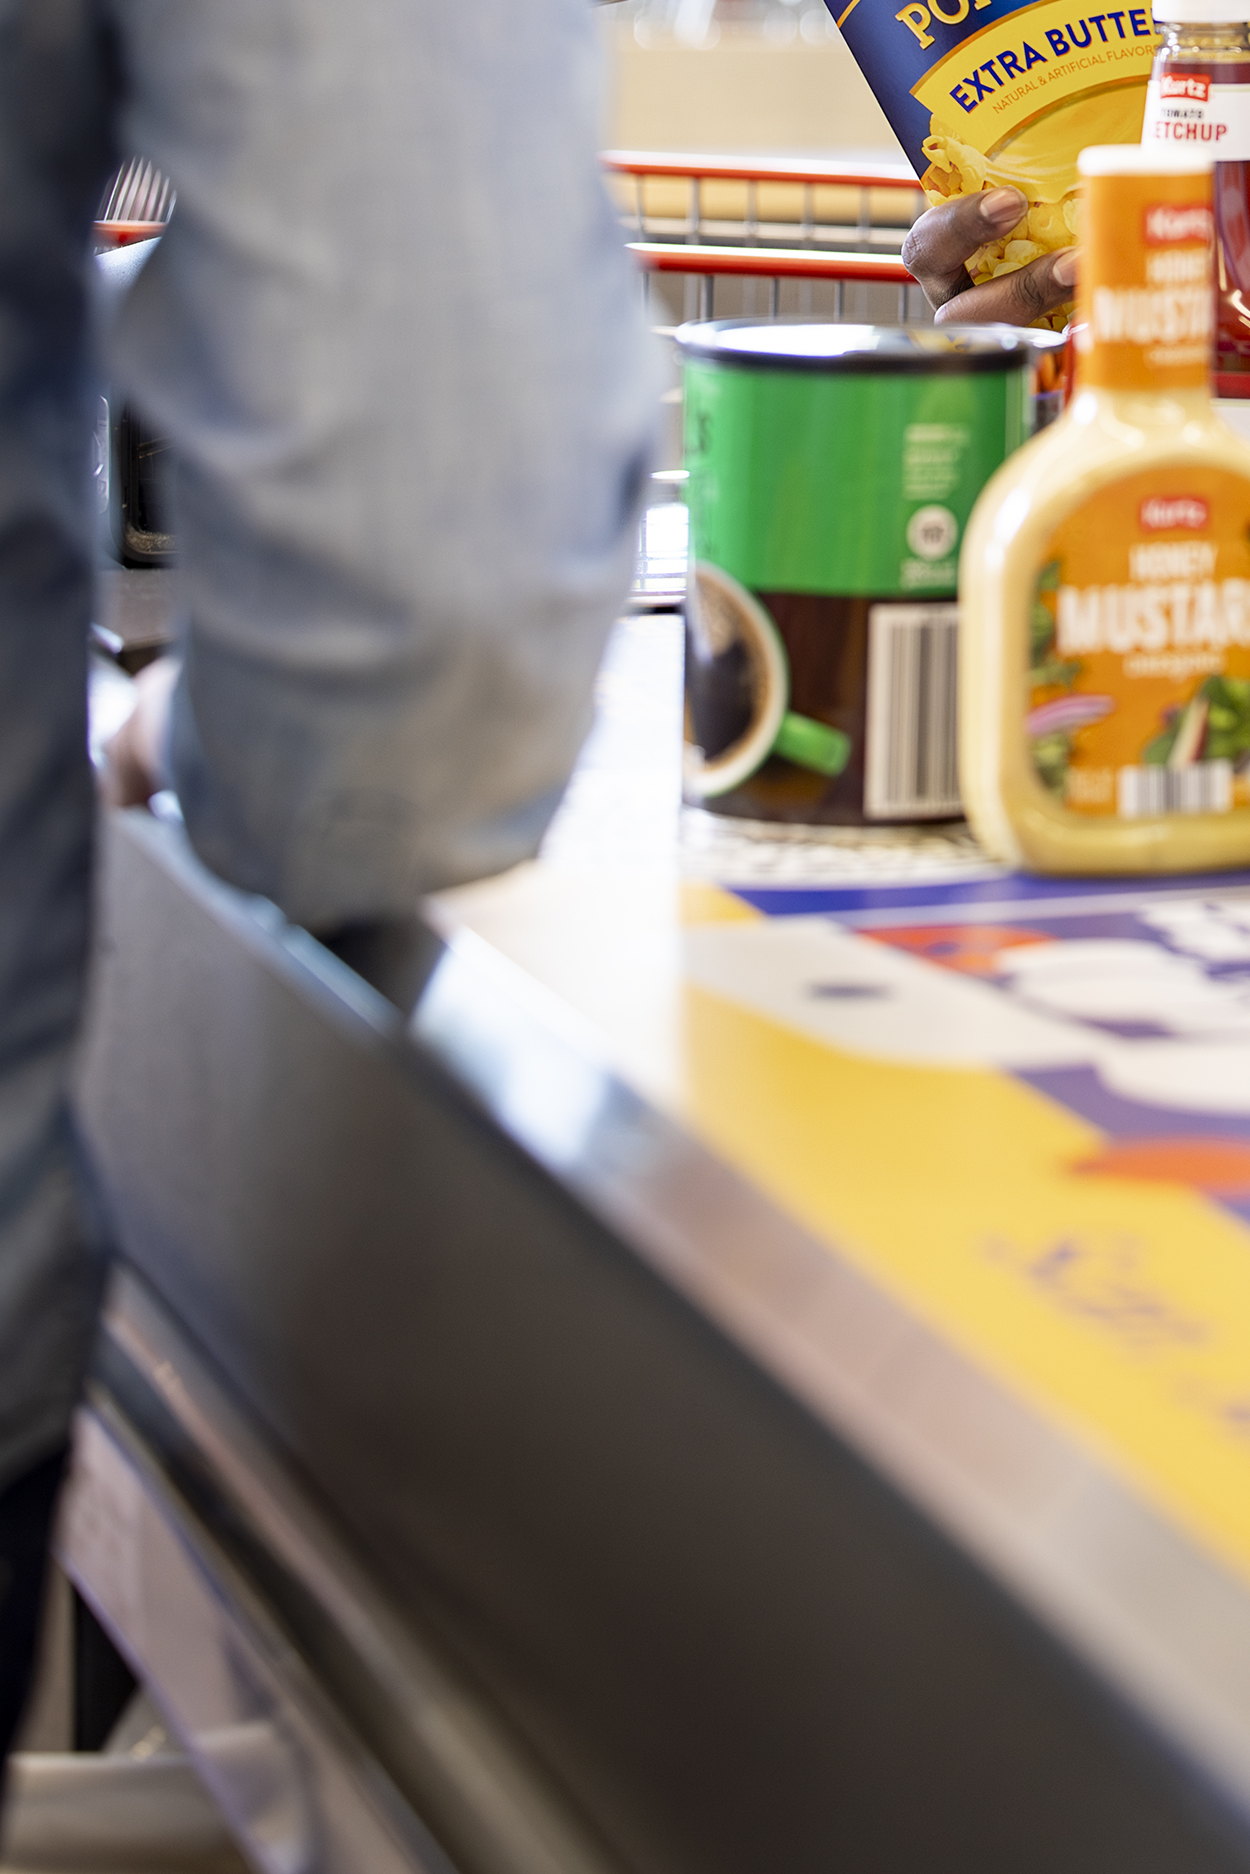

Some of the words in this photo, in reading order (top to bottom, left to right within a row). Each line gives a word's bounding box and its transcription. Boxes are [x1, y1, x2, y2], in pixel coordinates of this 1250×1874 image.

[949, 40, 1048, 115] EXTRA
[1044, 7, 1160, 57] BUTTE
[992, 79, 1039, 115] NATURAL
[1038, 74, 1048, 87] &
[1047, 54, 1106, 84] ARTIFICIAL
[1154, 121, 1228, 141] ETCHUP
